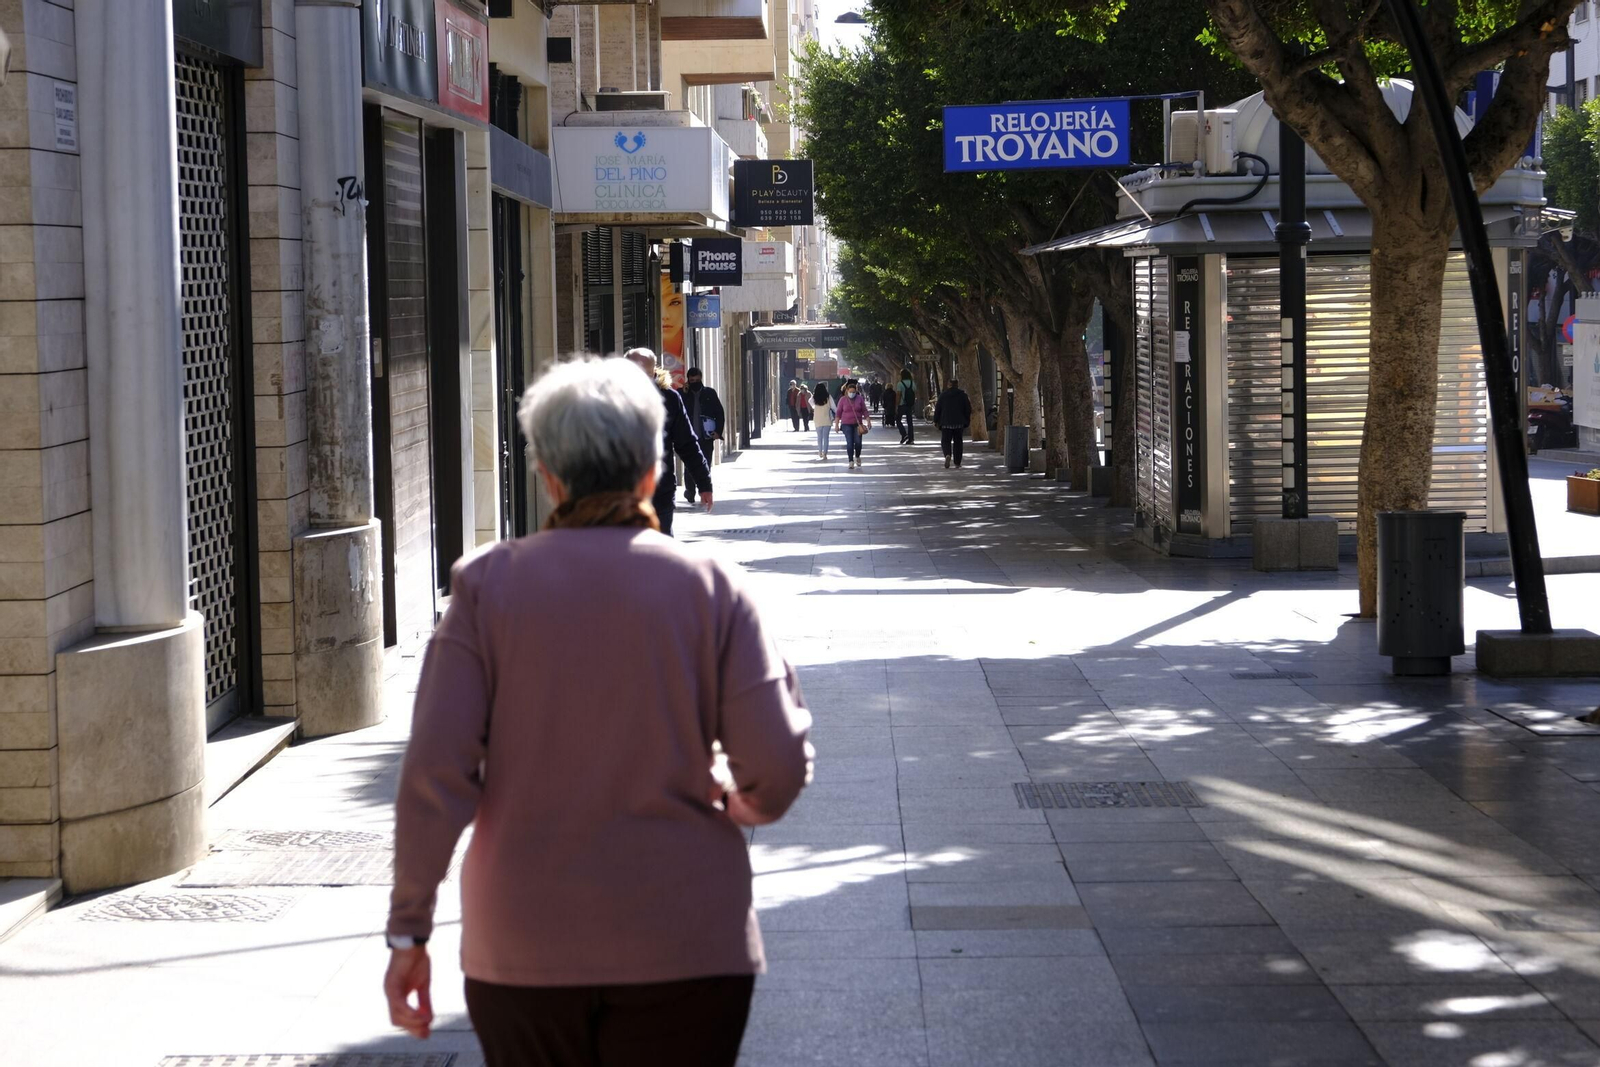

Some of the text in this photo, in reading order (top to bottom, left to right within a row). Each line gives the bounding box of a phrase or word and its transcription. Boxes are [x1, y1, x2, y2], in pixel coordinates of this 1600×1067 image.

[990, 106, 1116, 133] RELOJERÍA
[955, 130, 1119, 163] TROYANO
[627, 153, 667, 166] MARÍA
[595, 166, 667, 181] DEL PINO
[752, 189, 774, 197] PLAY
[698, 251, 737, 261] Phone
[698, 261, 737, 271] House
